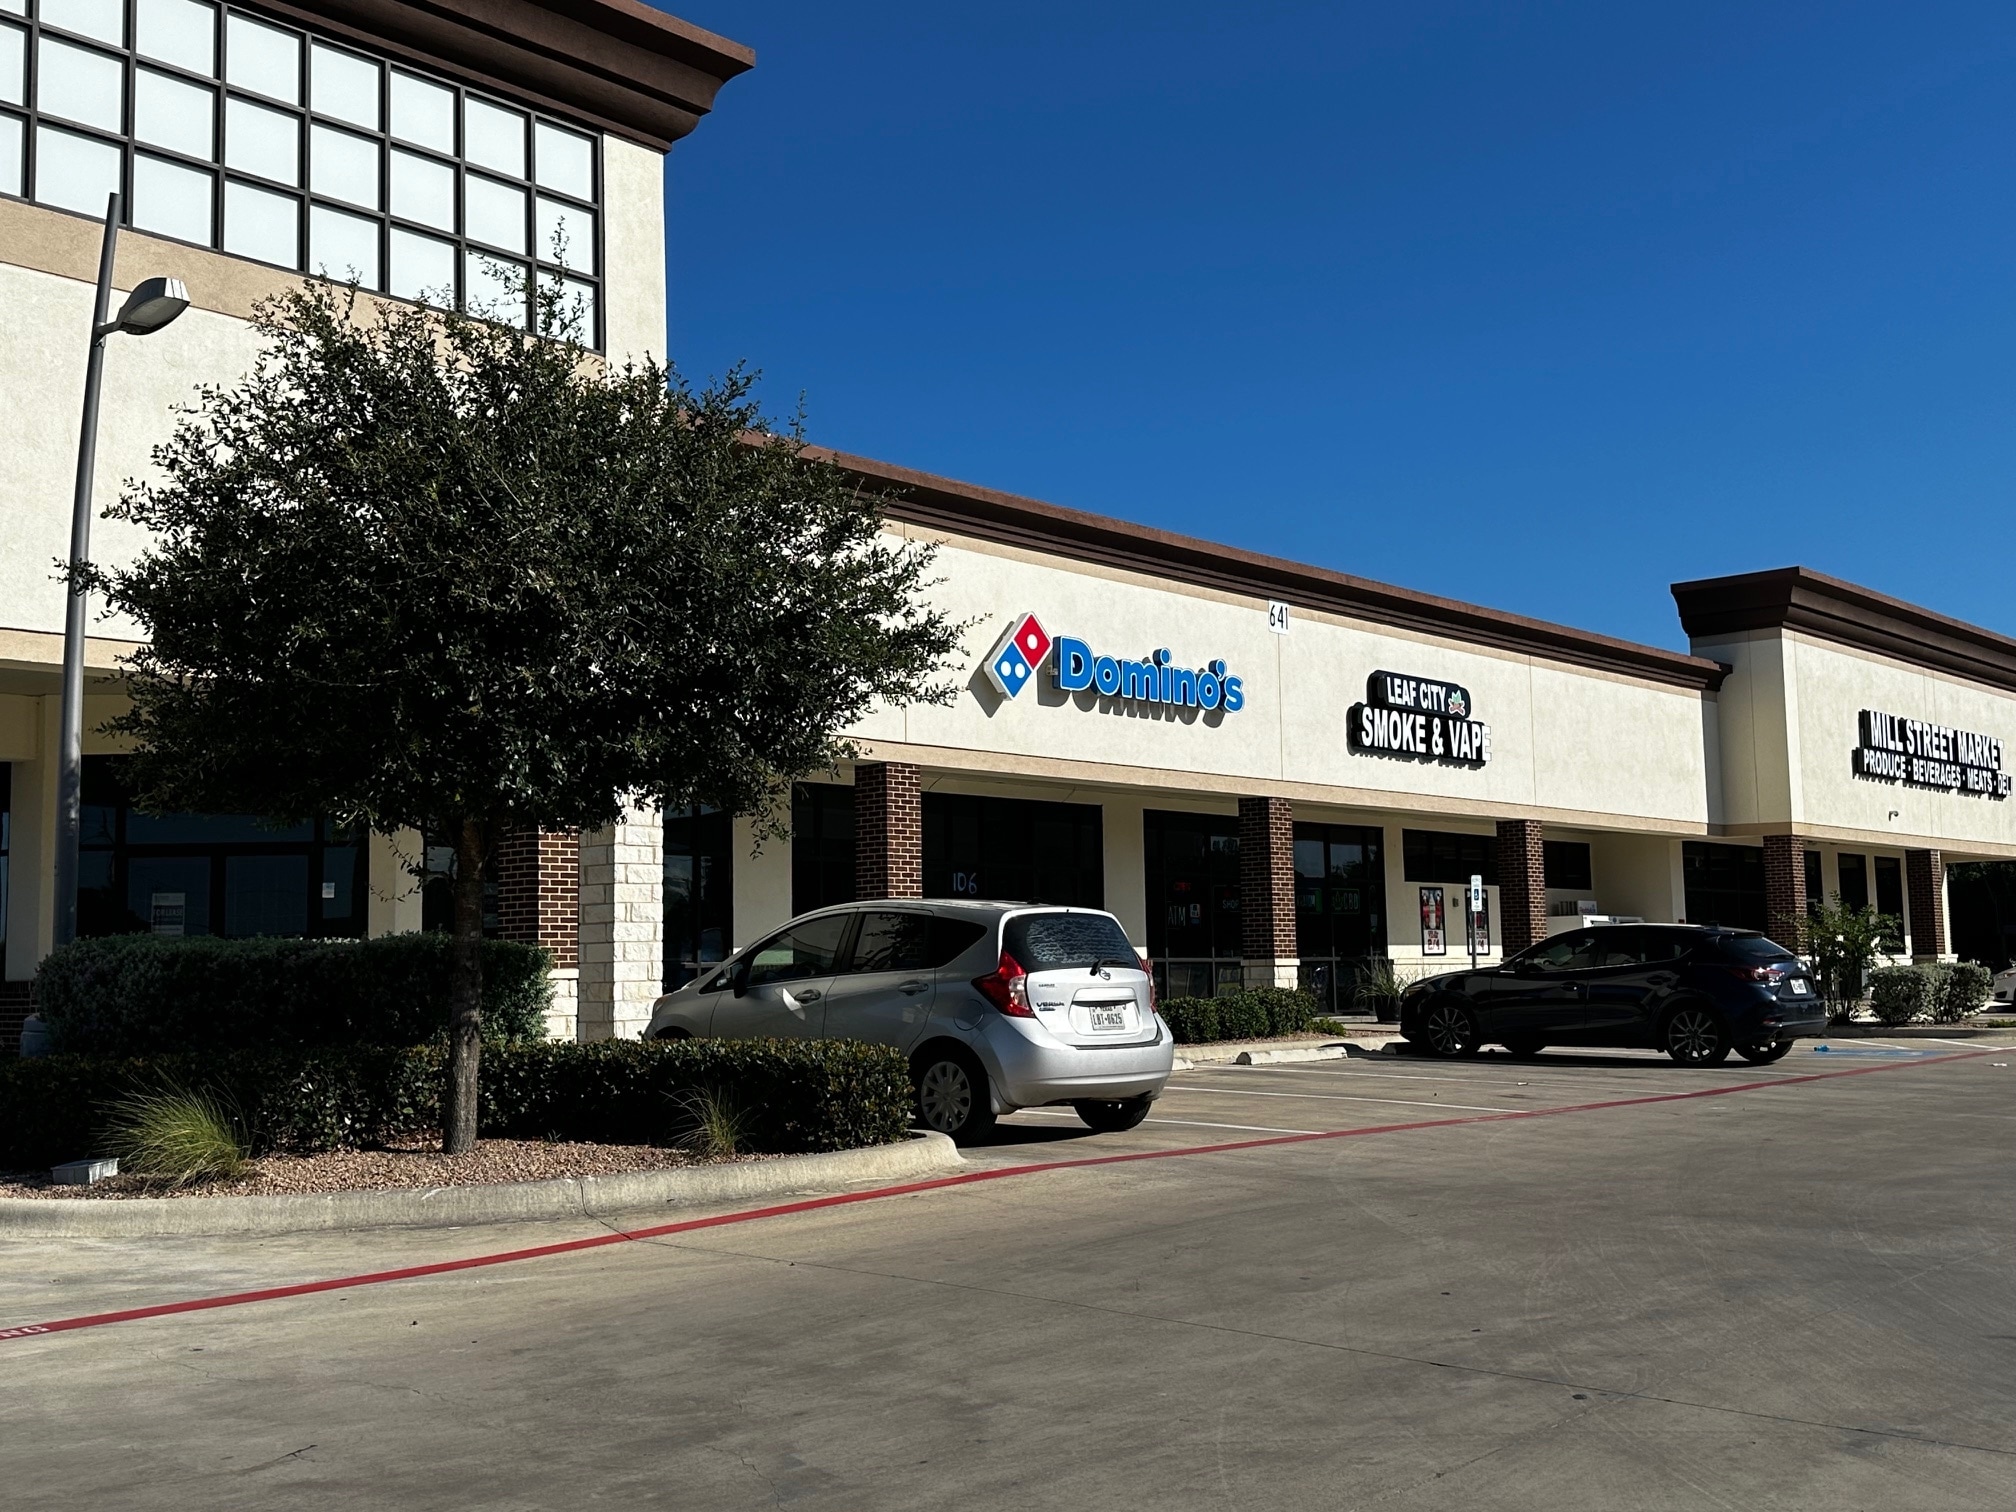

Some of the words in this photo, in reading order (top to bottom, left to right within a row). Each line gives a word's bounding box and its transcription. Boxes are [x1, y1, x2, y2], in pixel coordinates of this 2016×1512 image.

[1269, 605, 1289, 630] 641
[1058, 635, 1245, 713] Domino's
[1386, 676, 1417, 707] LEAF
[1419, 682, 1447, 712] CITY
[1361, 706, 1427, 754] SMOKE
[1431, 717, 1444, 755] &
[1448, 719, 1492, 762] VAPE
[1869, 710, 1904, 752] MILL
[1905, 718, 1955, 762] STREET
[1956, 729, 2004, 771] MARKET
[1863, 748, 1907, 779] PRODUCE
[1912, 757, 1961, 788] BEVERAGES
[1966, 767, 1993, 793] MEATS
[1167, 904, 1186, 928] ATM
